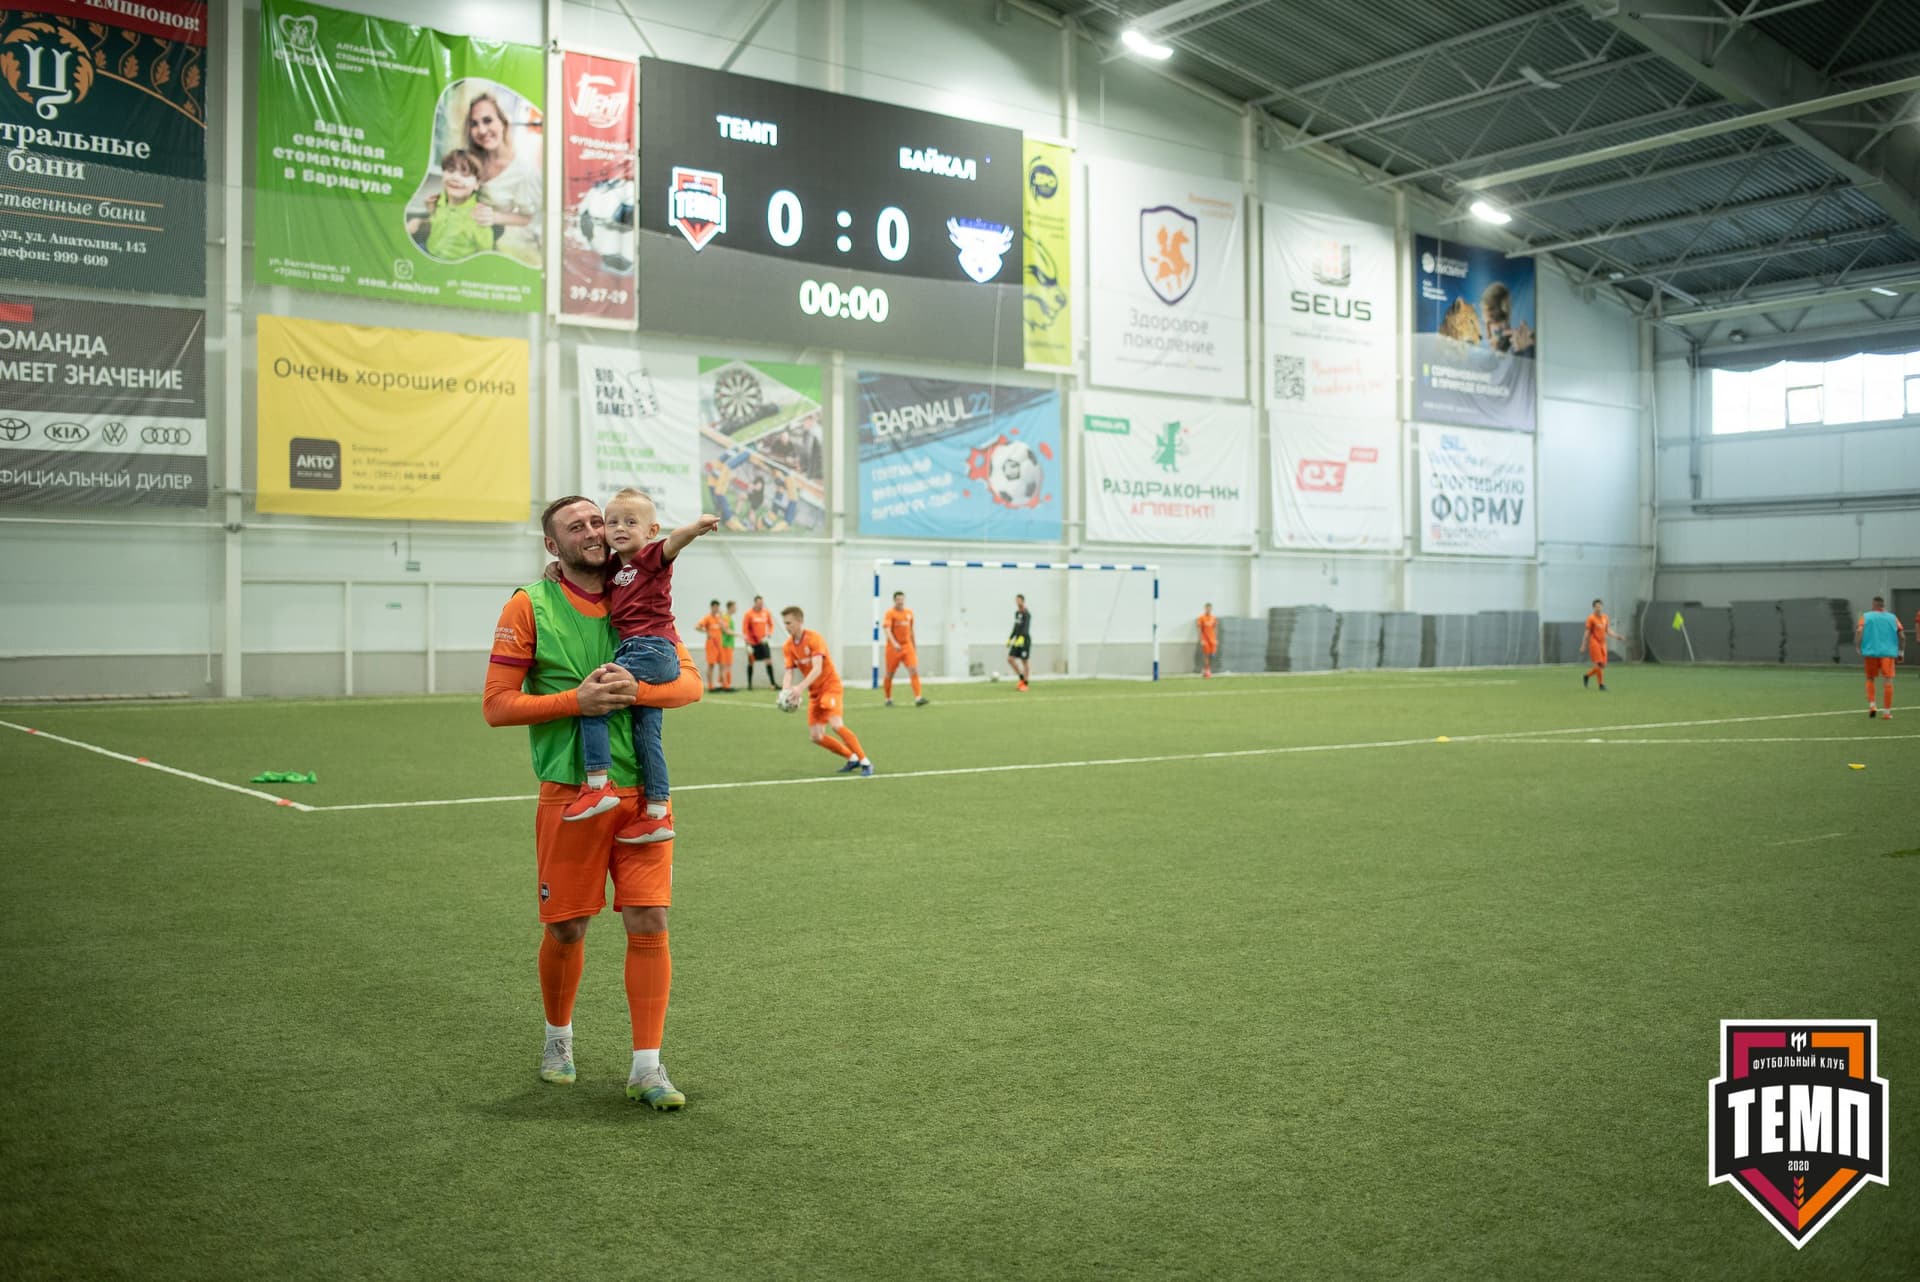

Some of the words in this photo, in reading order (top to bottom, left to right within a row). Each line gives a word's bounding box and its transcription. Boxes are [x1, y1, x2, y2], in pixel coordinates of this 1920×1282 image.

[314, 119, 365, 140] Ваша
[716, 114, 778, 146] ТЕМП
[292, 133, 385, 159] семейная
[7, 149, 86, 180] бани
[272, 146, 404, 180] стоматология
[899, 146, 977, 181] БАЙКАЛ
[302, 168, 393, 195] Барнауле
[98, 201, 147, 223] бани
[767, 189, 804, 248] 0
[876, 206, 911, 262] 0
[799, 279, 890, 323] 00:00
[1290, 290, 1372, 322] SEUS
[1129, 306, 1209, 336] Здоровое
[1122, 331, 1216, 357] поколение
[64, 364, 183, 390] ЗНАЧЕНИЕ
[273, 357, 349, 384] Очень
[355, 369, 458, 392] хорошие
[463, 377, 516, 396] окна
[296, 453, 335, 471] АКТО
[135, 472, 193, 492] ДИЛЕР
[1430, 493, 1524, 526] ФОРМУ
